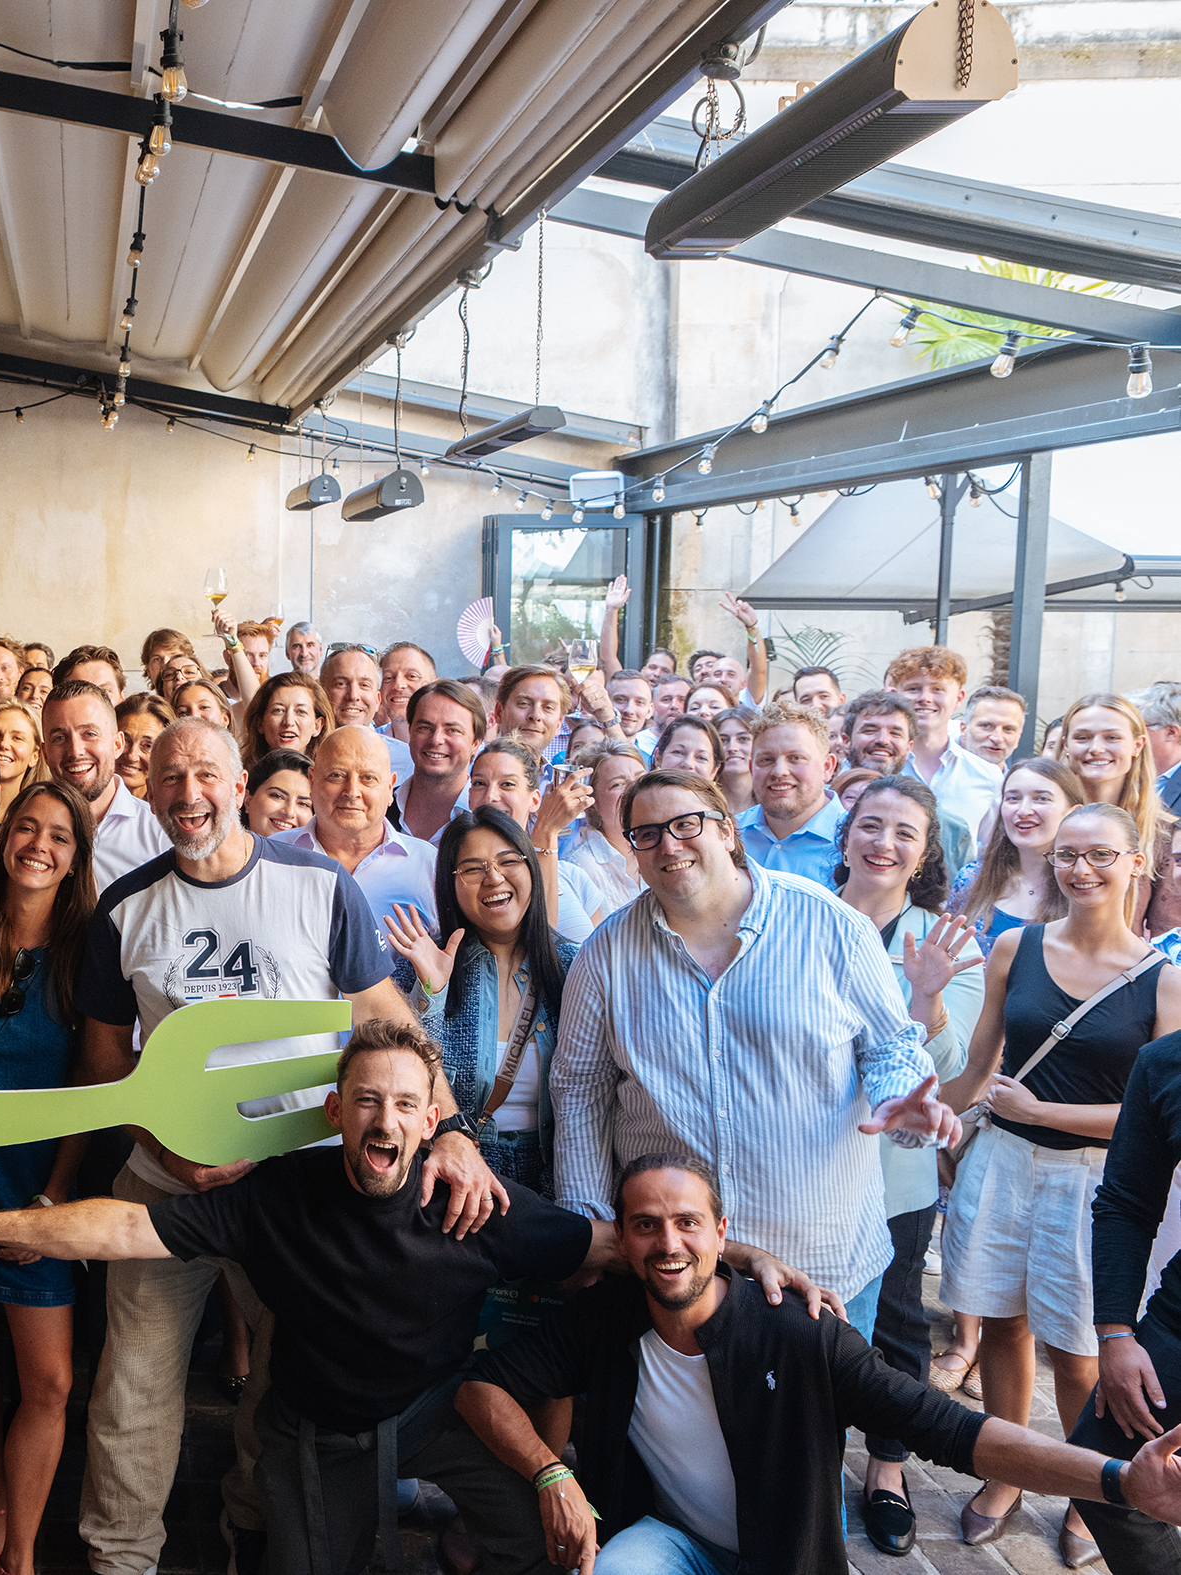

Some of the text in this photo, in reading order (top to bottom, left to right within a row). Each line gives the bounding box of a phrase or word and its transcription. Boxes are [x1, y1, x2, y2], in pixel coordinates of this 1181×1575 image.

[182, 927, 260, 996] 24
[184, 982, 237, 994] DEPUIS 1923
[487, 1288, 509, 1296] eFork
